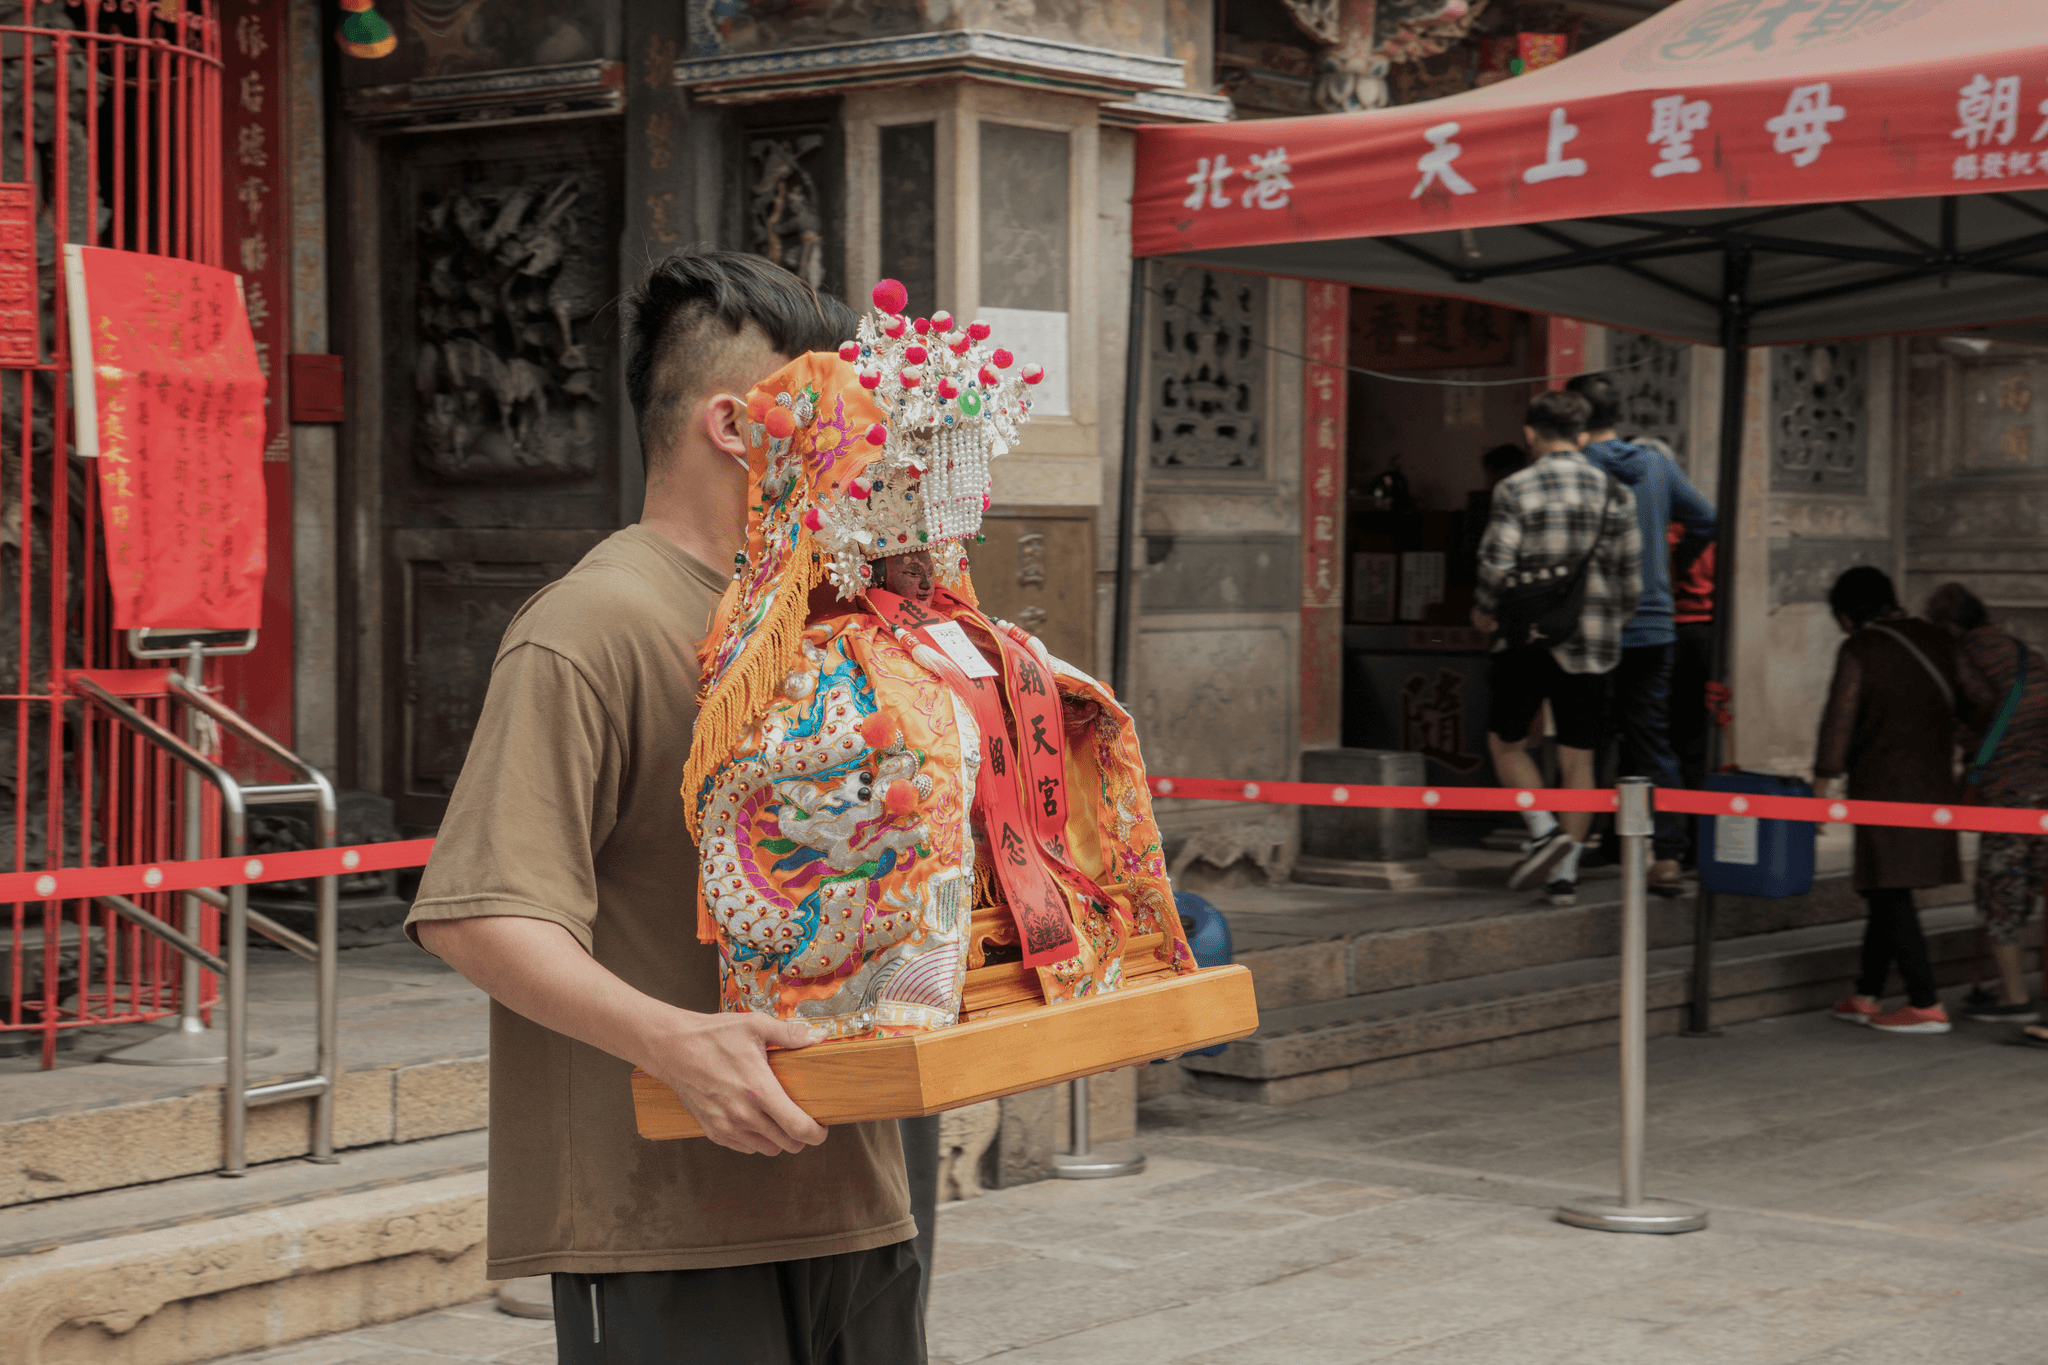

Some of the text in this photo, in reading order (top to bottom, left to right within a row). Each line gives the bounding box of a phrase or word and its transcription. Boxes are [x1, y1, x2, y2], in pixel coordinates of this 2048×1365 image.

[1184, 147, 1293, 210] 北港
[1410, 82, 1846, 200] 天上聖母
